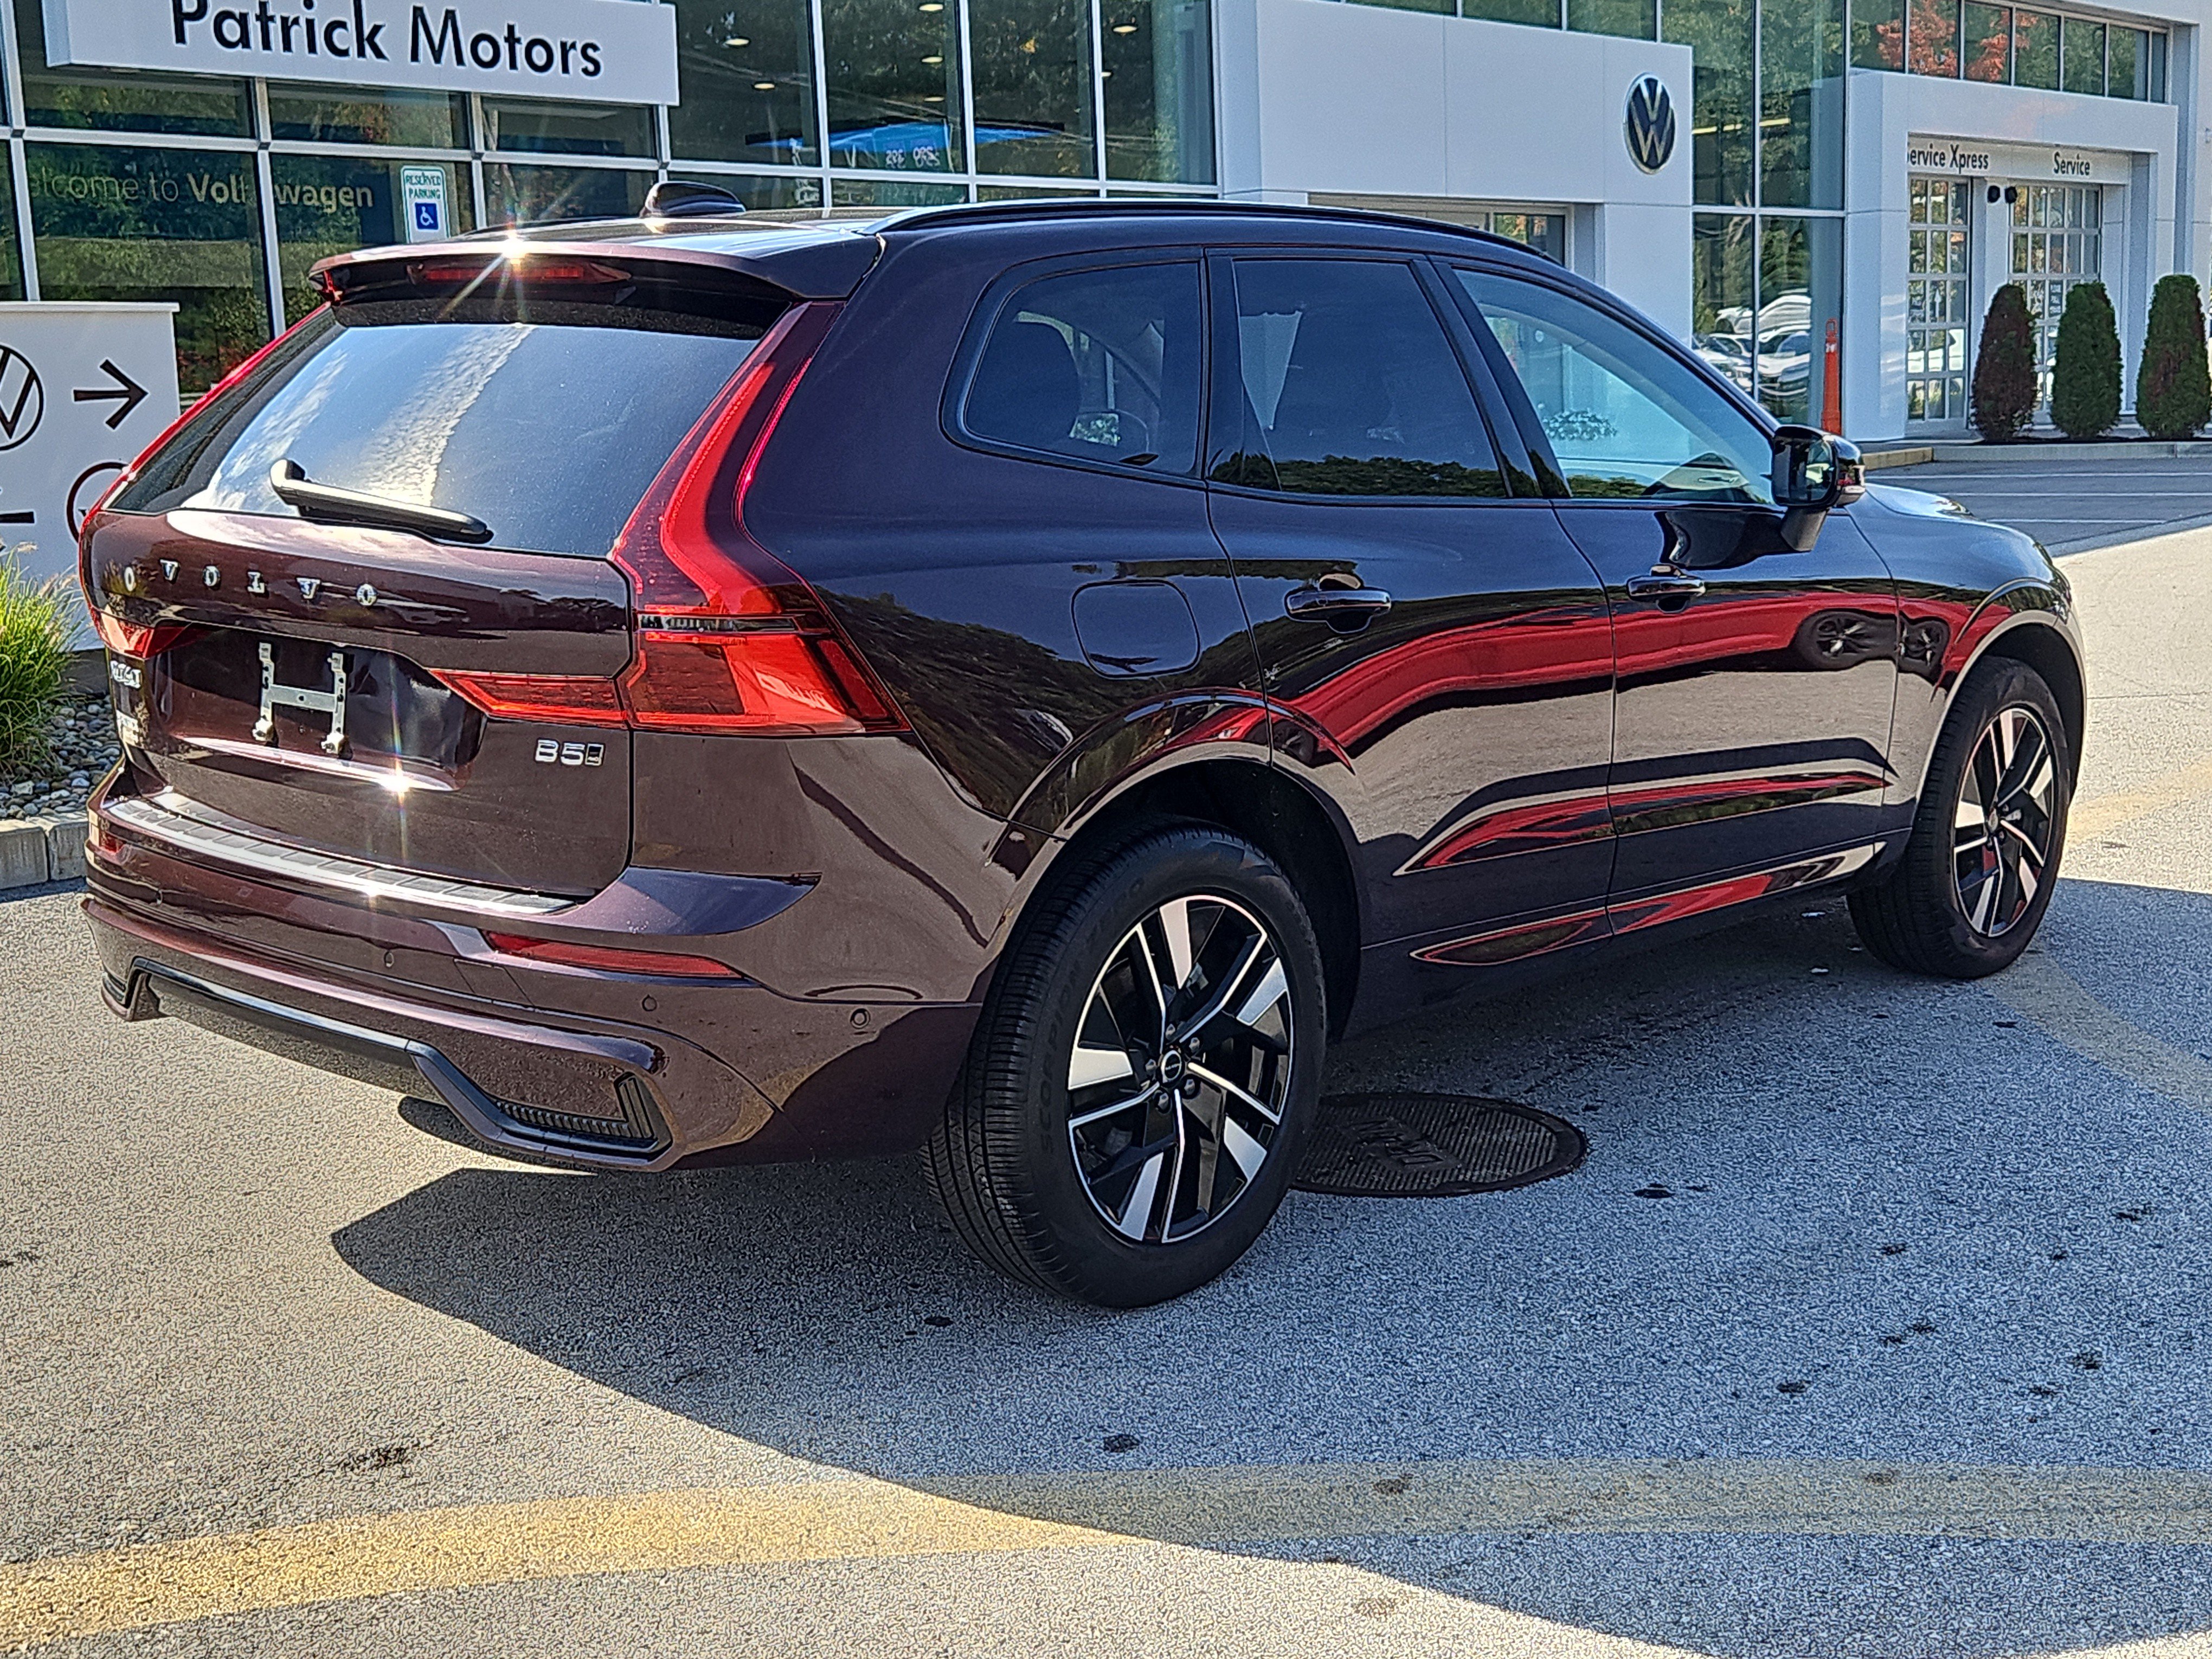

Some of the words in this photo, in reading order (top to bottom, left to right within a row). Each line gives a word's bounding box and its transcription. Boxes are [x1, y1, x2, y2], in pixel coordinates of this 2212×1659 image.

[173, 0, 389, 61] Patrick
[409, 5, 602, 77] Motors
[1907, 143, 1946, 167] ervice
[1950, 144, 1989, 174] Xpress
[2054, 151, 2091, 176] Service
[150, 171, 178, 202] to
[405, 172, 441, 185] RESERVED
[408, 188, 441, 199] PARKING
[159, 558, 378, 607] VOLVO
